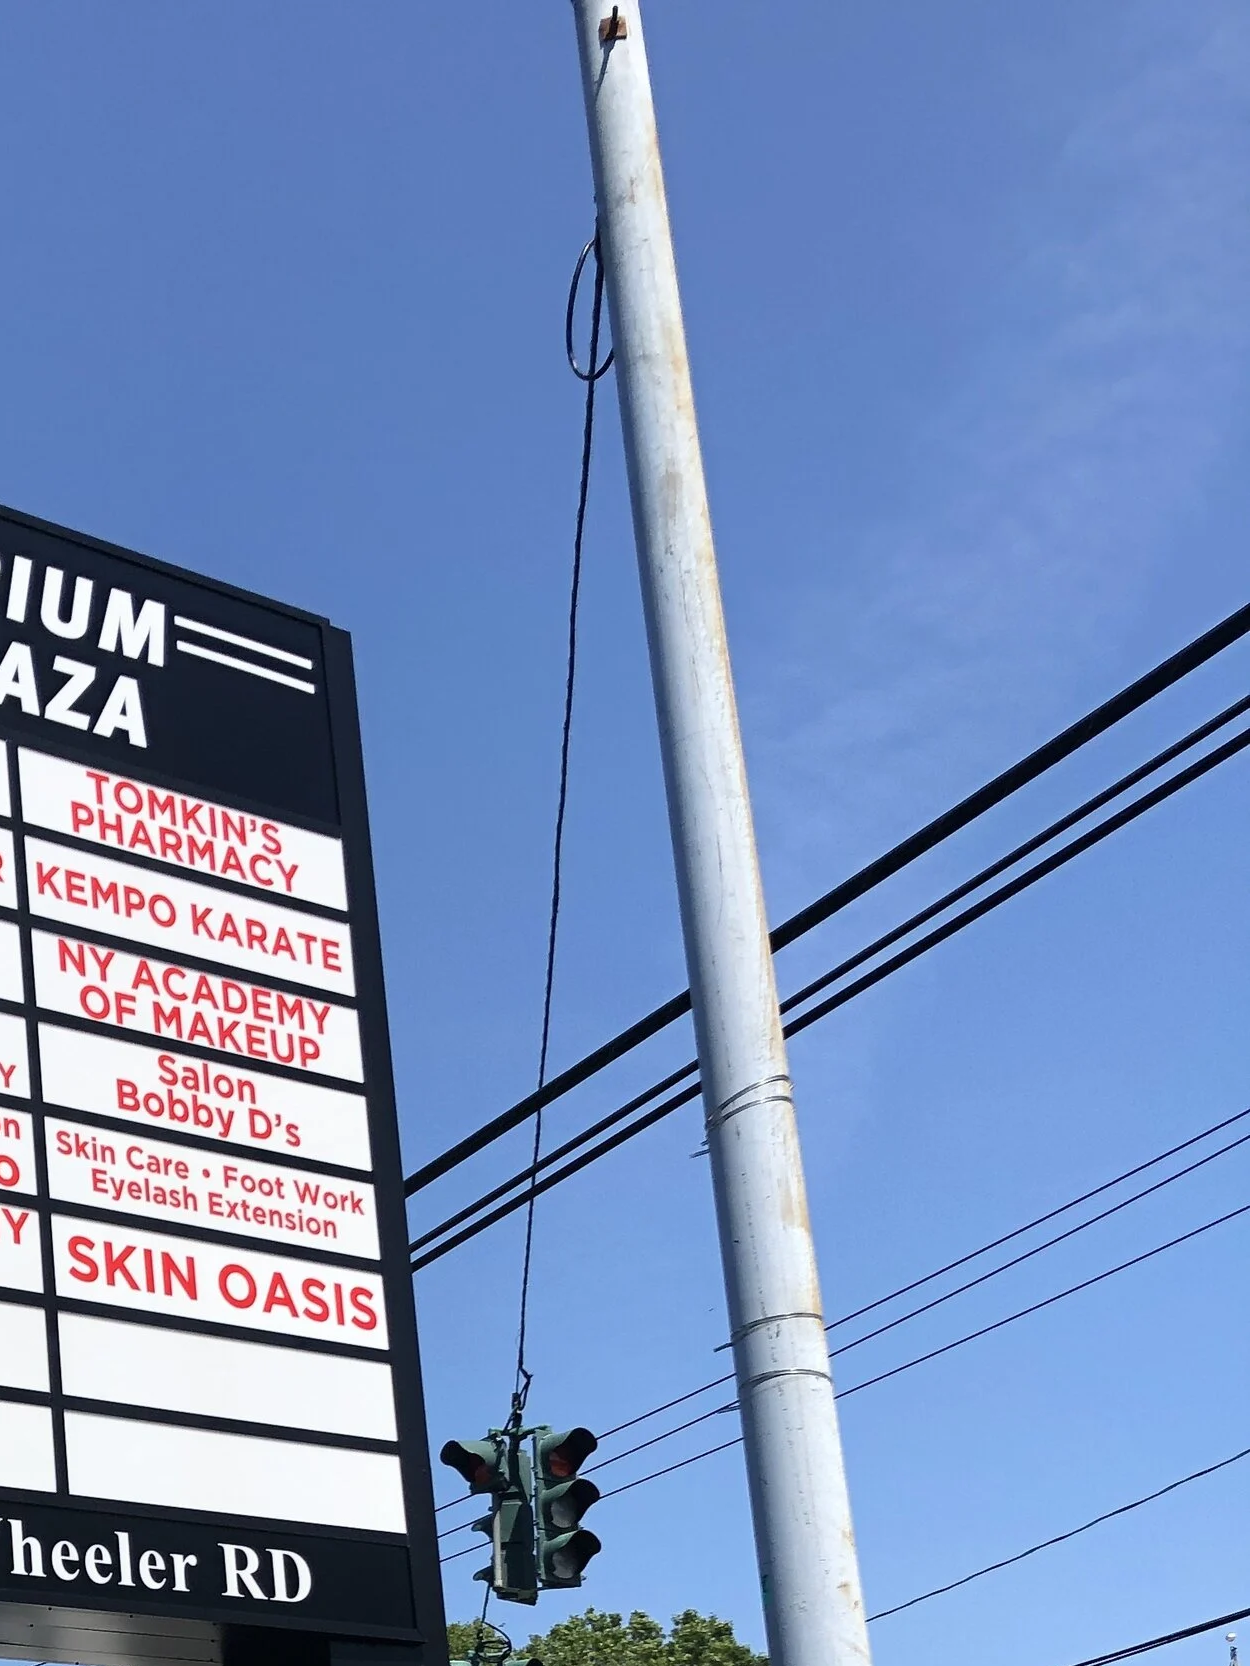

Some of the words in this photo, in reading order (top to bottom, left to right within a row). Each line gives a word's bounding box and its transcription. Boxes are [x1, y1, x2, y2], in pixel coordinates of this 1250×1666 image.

[70, 799, 298, 892] PHARMACY
[86, 771, 282, 856] TOMKIN'S
[36, 862, 177, 928] KEMPO
[190, 903, 342, 972] KARATE
[57, 938, 115, 982] NY
[131, 959, 331, 1034] ACADEMY
[79, 984, 136, 1025] OF
[152, 1001, 321, 1067] MAKEUP
[116, 1078, 235, 1140] Bobby
[248, 1108, 301, 1147] D's
[157, 1054, 256, 1104] Salon
[56, 1130, 116, 1164] Skin
[126, 1145, 190, 1180] Care
[223, 1165, 285, 1199] Foot
[294, 1182, 365, 1216] Work
[91, 1167, 198, 1210] Eyelash
[208, 1191, 339, 1239] Extension
[67, 1235, 198, 1301] SKIN
[217, 1263, 378, 1331] OASIS
[219, 1541, 313, 1604] RD
